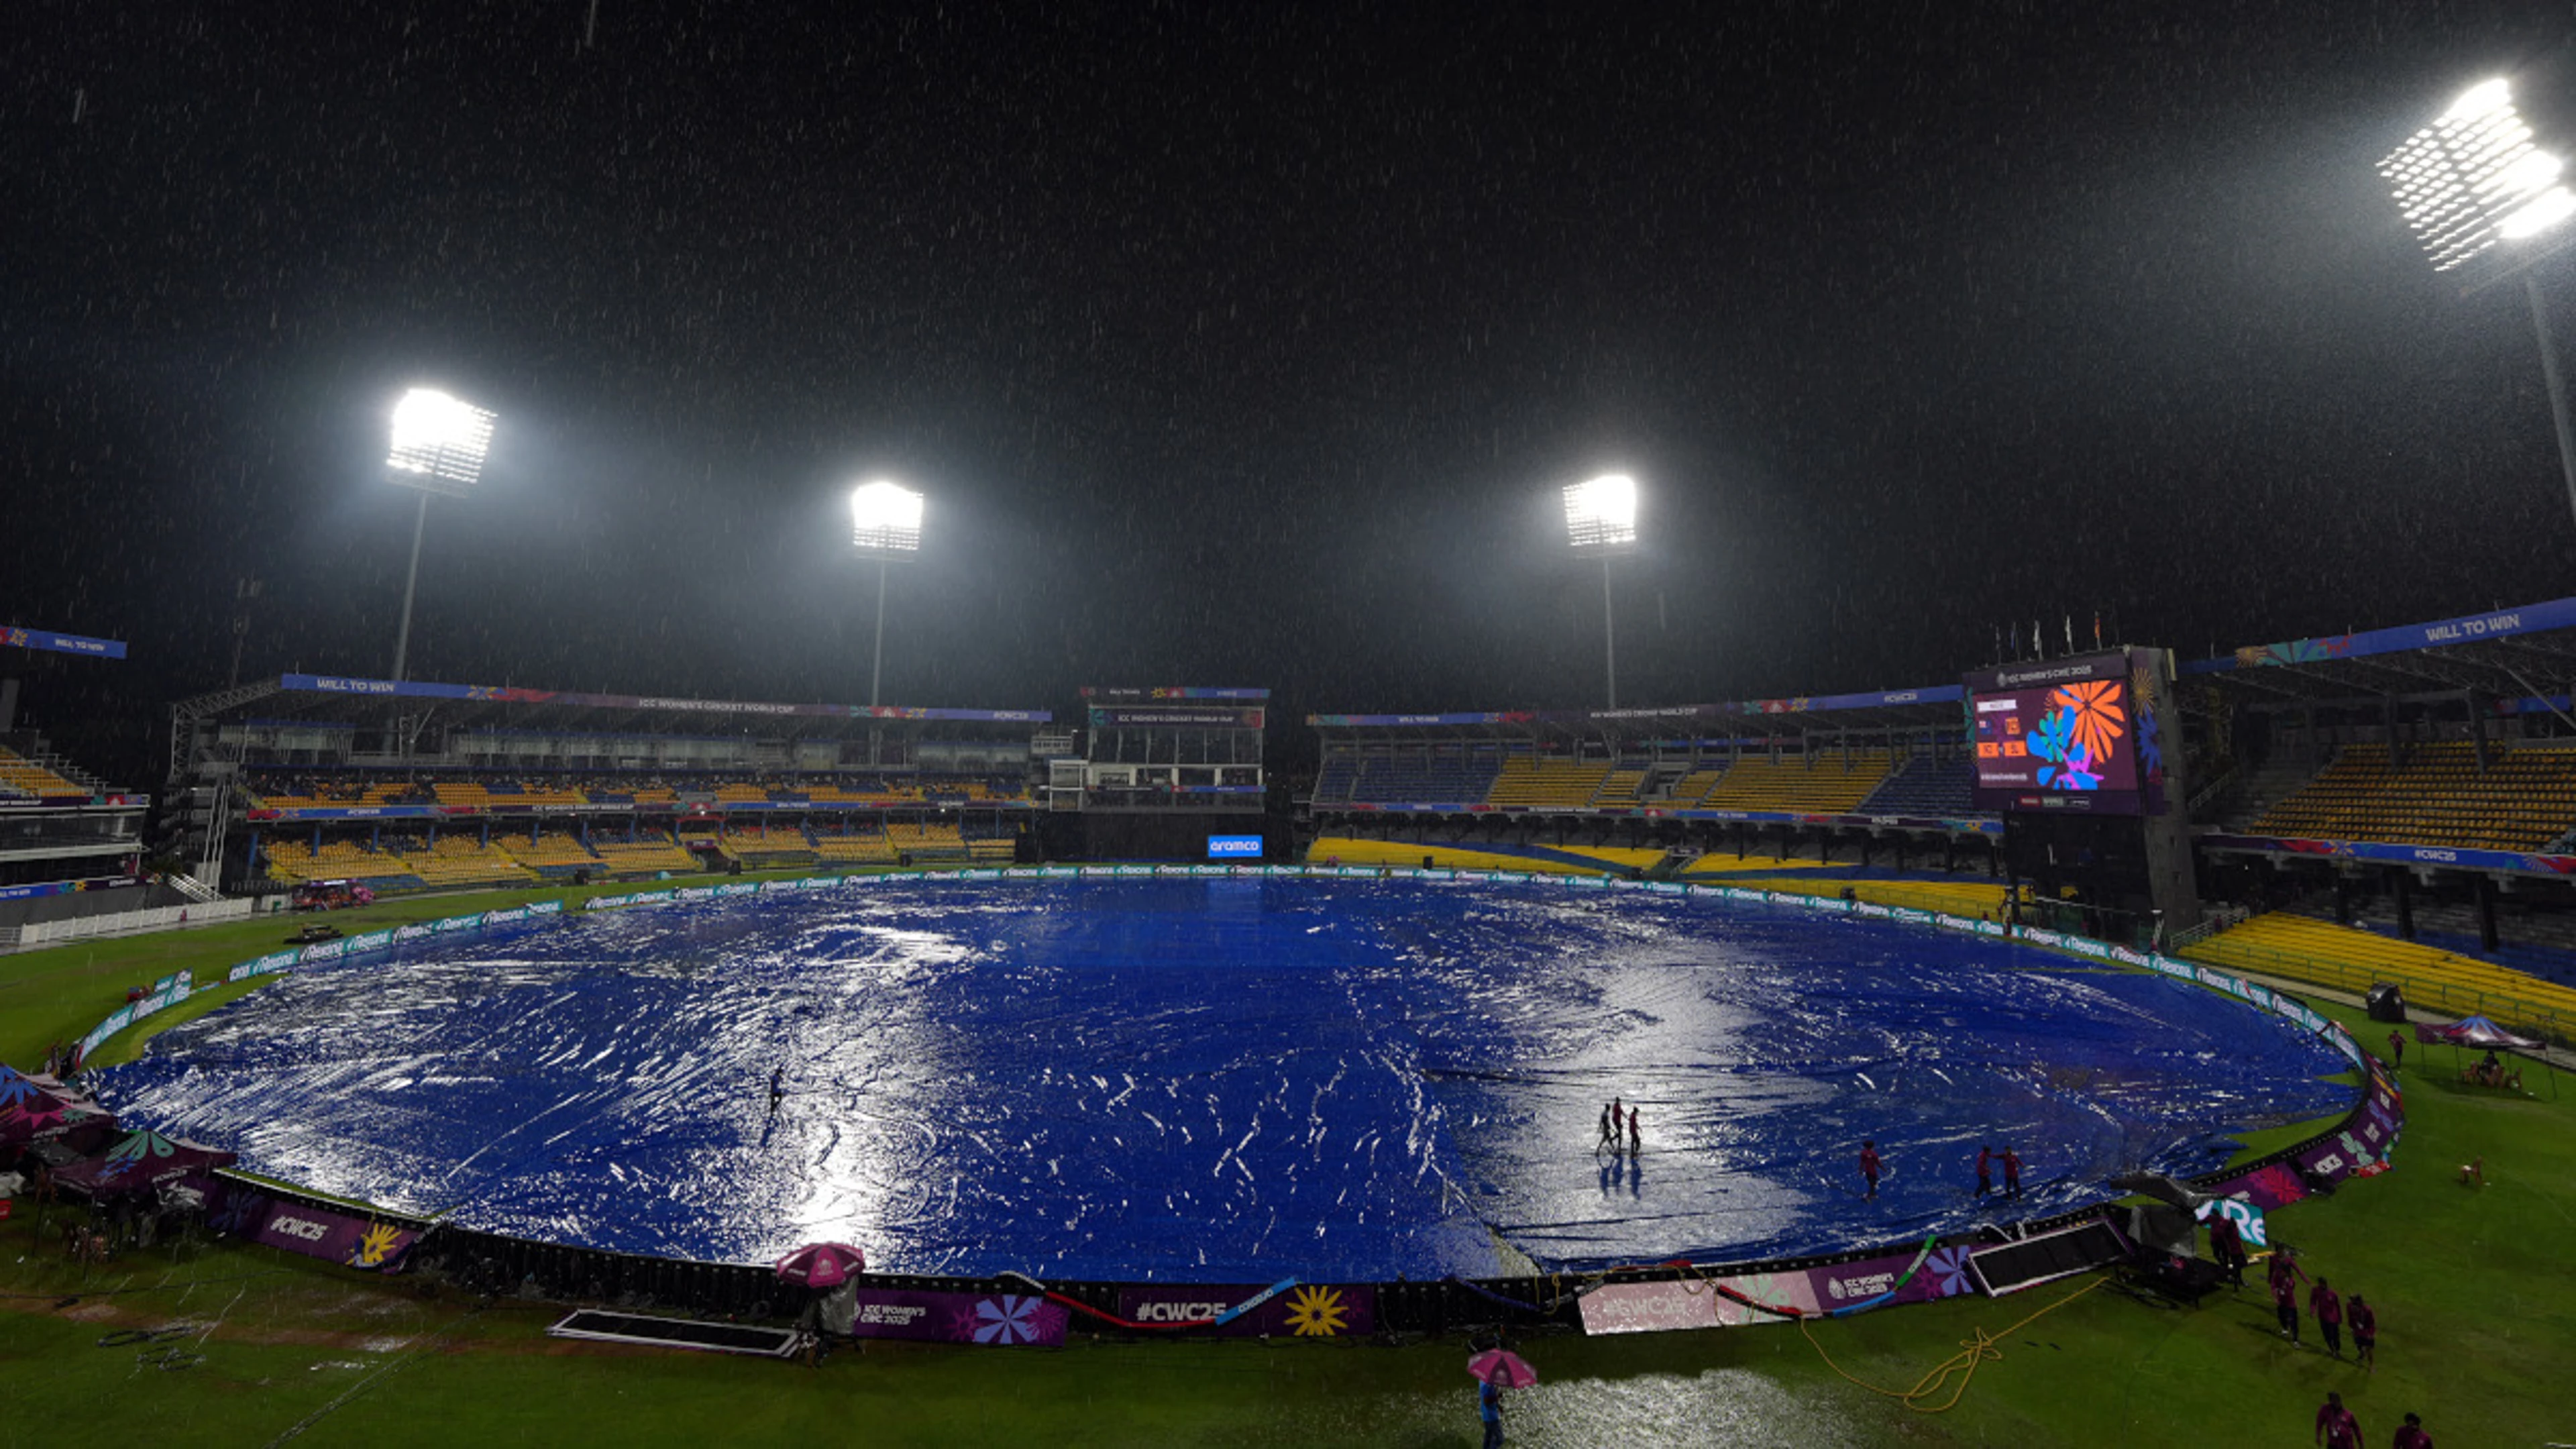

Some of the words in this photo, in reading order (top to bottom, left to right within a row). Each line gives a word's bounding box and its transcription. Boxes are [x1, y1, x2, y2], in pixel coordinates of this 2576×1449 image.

[2426, 625, 2462, 642] WILL
[2462, 621, 2486, 635] TO
[2487, 614, 2520, 631] WIN
[317, 679, 347, 690] WILL
[350, 680, 368, 690] TO
[369, 682, 394, 692] WIN
[1210, 841, 1259, 851] aramco
[2414, 849, 2457, 861] #CWC25
[270, 1214, 329, 1241] #CWC25
[864, 1305, 881, 1314] ICC
[882, 1305, 926, 1317] WOMEN'S
[1136, 1302, 1227, 1321] #CWC25
[1603, 1296, 1686, 1316] #CWC25
[861, 1313, 883, 1324] CWC
[884, 1315, 911, 1326] 2025
